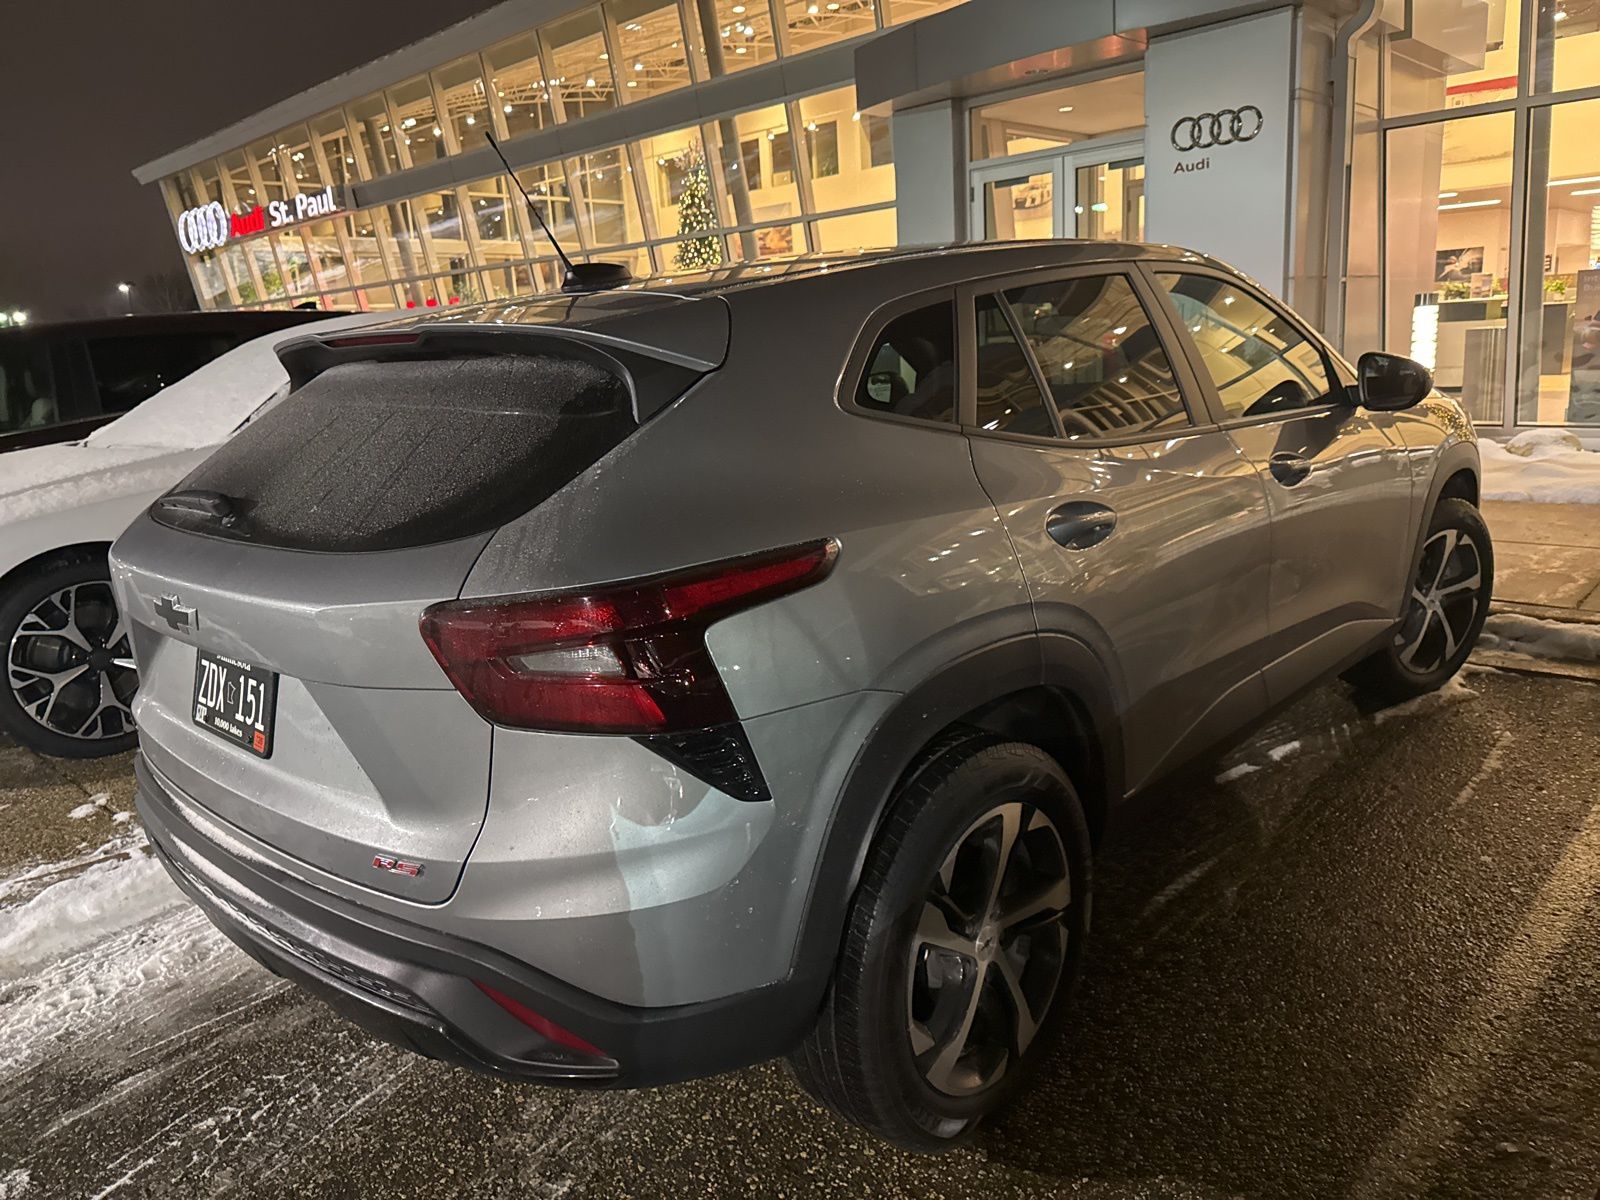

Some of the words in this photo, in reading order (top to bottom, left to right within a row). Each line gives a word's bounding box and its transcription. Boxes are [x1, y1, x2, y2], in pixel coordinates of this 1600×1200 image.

[1173, 157, 1210, 174] Audi
[230, 204, 265, 239] Audi
[269, 200, 294, 227] St.
[295, 185, 337, 220] Paul
[198, 658, 227, 713] ZDX
[235, 675, 265, 732] 151
[371, 854, 419, 877] RS
